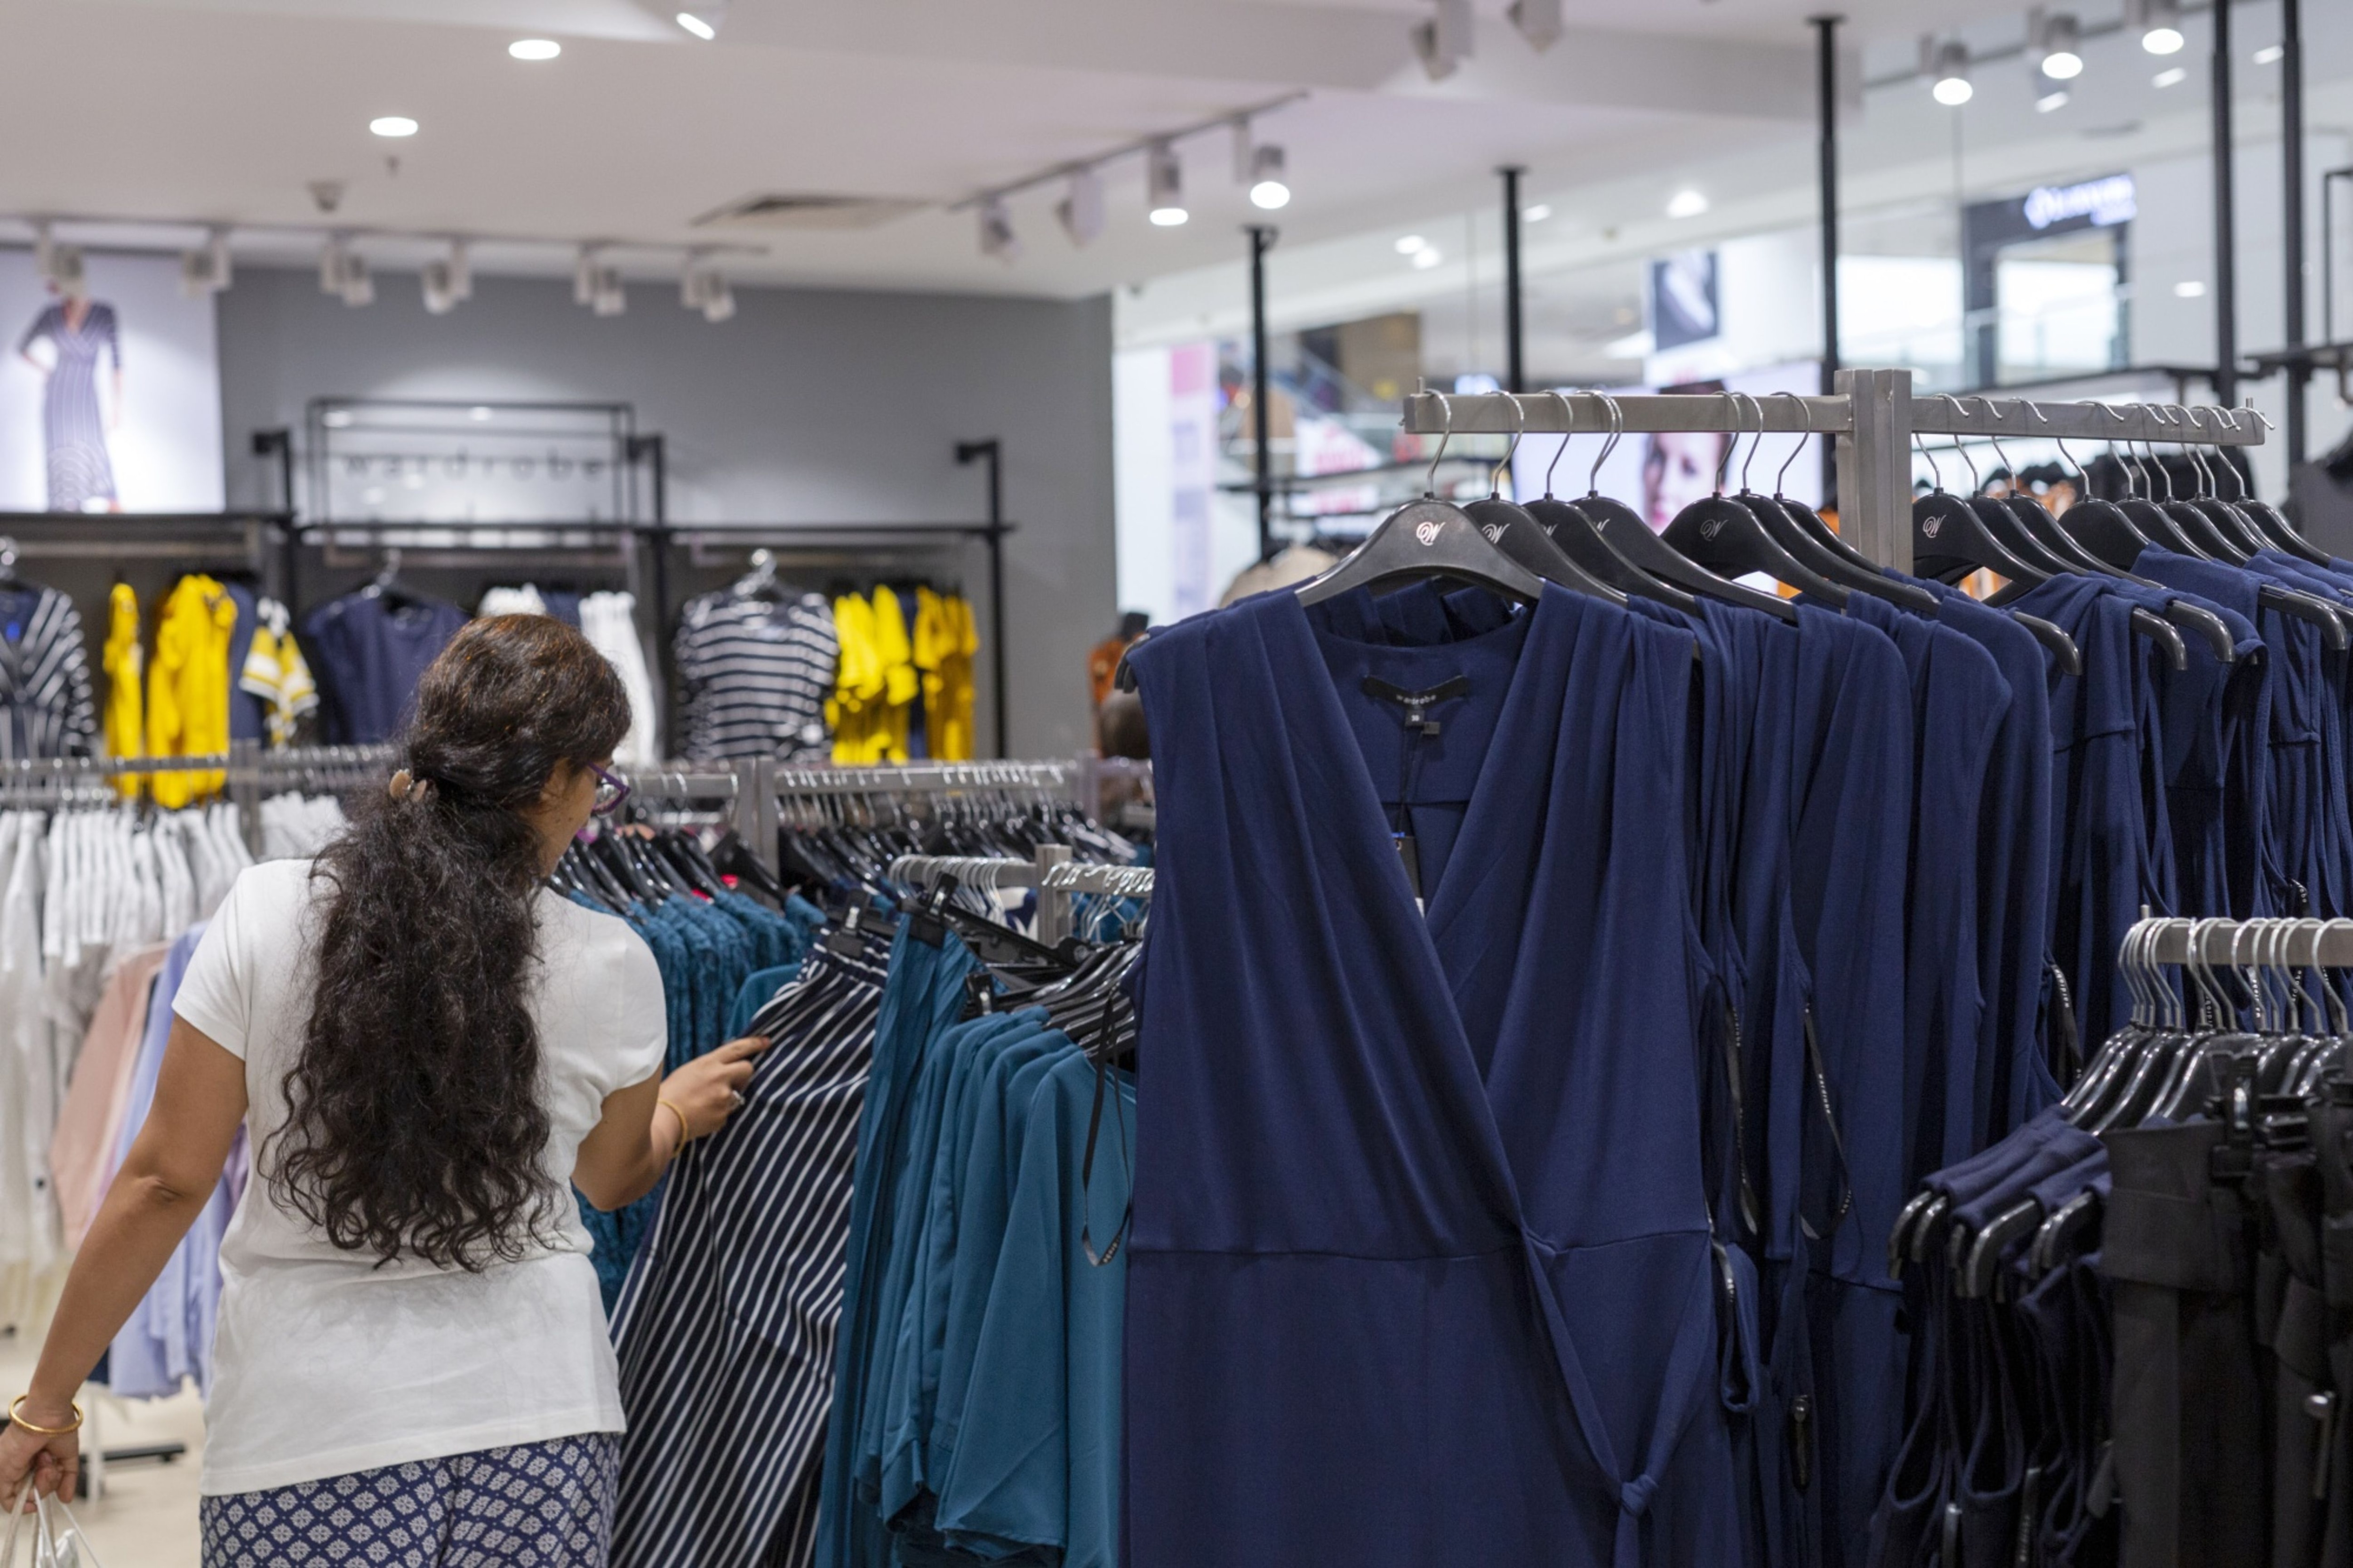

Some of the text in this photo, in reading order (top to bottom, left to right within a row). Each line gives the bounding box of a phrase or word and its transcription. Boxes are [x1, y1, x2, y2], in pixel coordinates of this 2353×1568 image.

[1396, 694, 1436, 705] wardrobe
[2055, 968, 2070, 1008] wardrobe
[2252, 979, 2261, 1018] wadrobe
[2291, 970, 2302, 1002] ardobe
[2205, 995, 2213, 1028] rdrob
[1818, 1073, 1831, 1114] wardrobe
